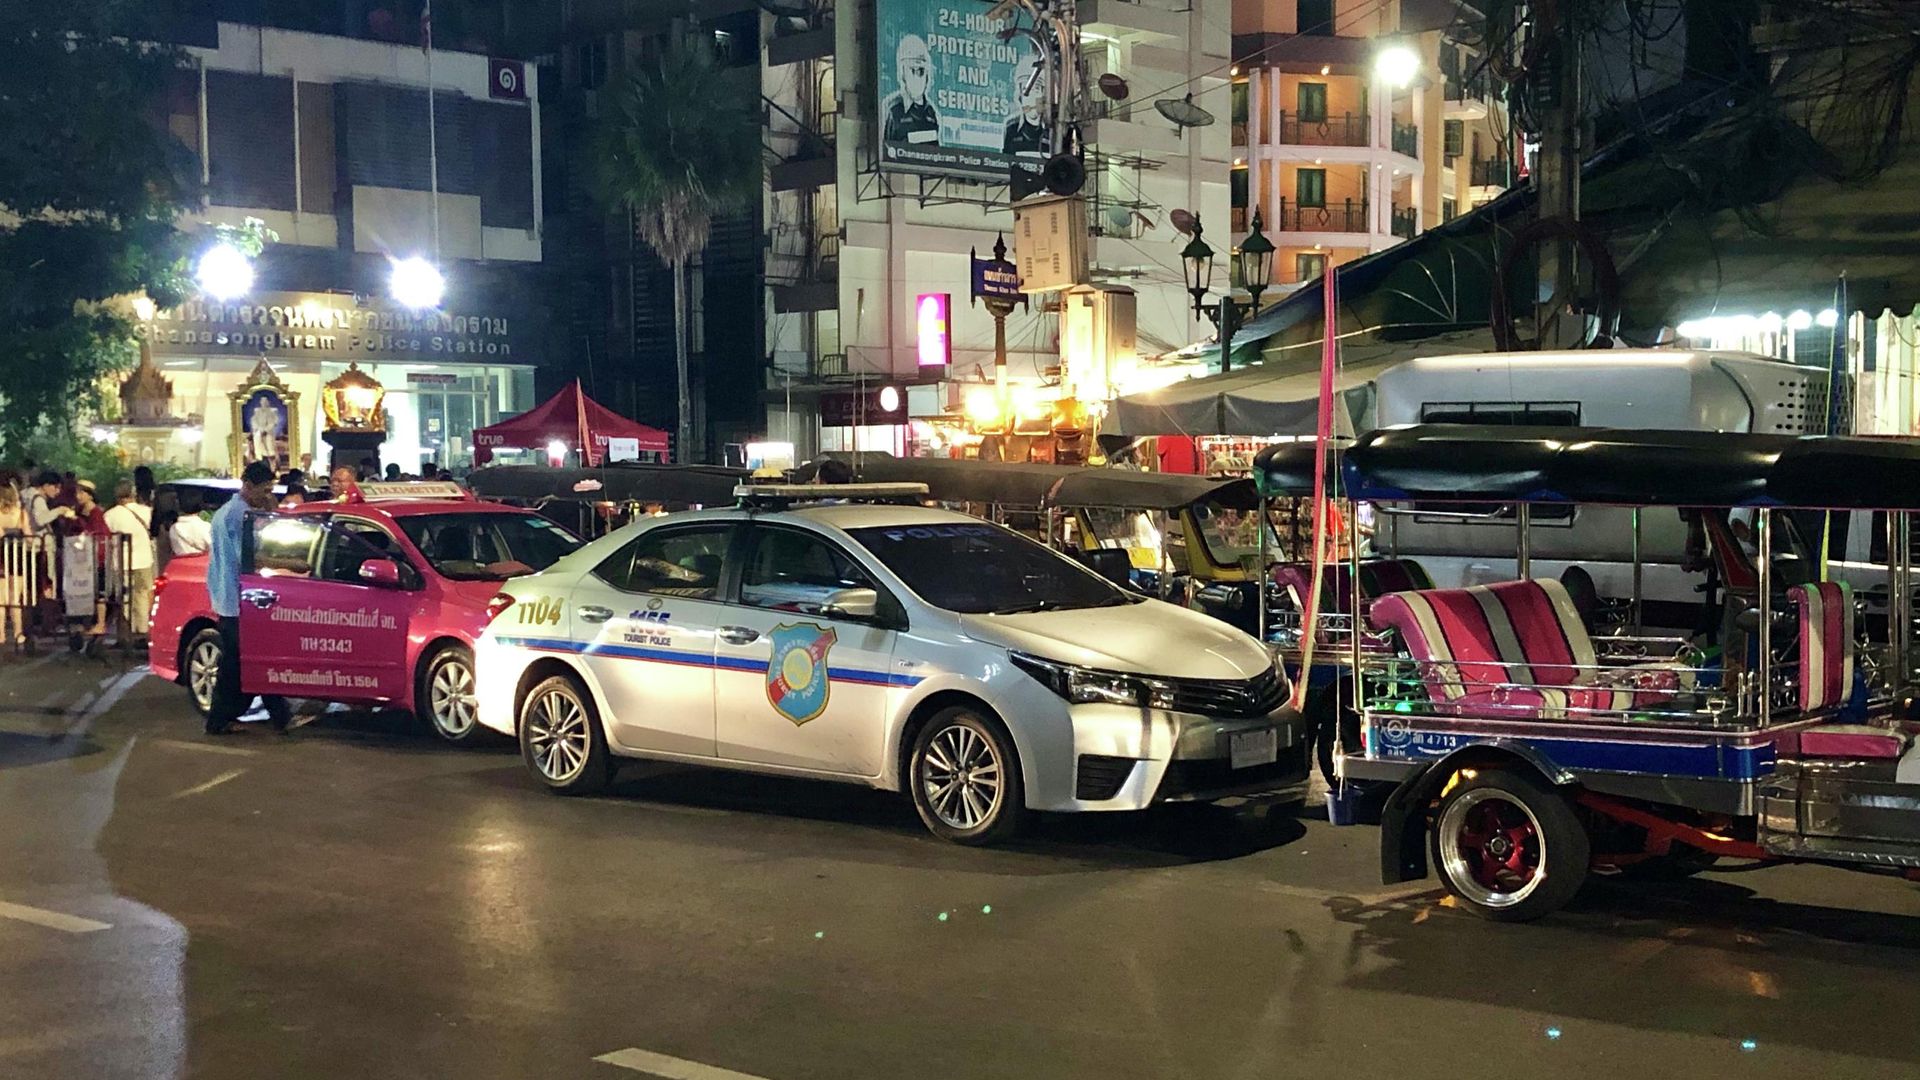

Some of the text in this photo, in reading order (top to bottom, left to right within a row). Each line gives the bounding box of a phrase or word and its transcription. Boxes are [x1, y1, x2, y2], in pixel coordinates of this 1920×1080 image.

[938, 8, 1004, 33] 24-HOUR
[927, 34, 1017, 64] PROTECTION
[958, 65, 989, 87] AND
[938, 89, 1008, 115] SERVICES
[896, 147, 957, 164] Chanasongkram
[959, 155, 981, 167] Police
[983, 157, 1009, 169] Station
[133, 323, 511, 356] Chanasongkram Police Station
[477, 433, 504, 446] true
[594, 434, 610, 447] tru
[518, 596, 564, 626] 1104
[623, 633, 671, 646] TOURIST POLICE
